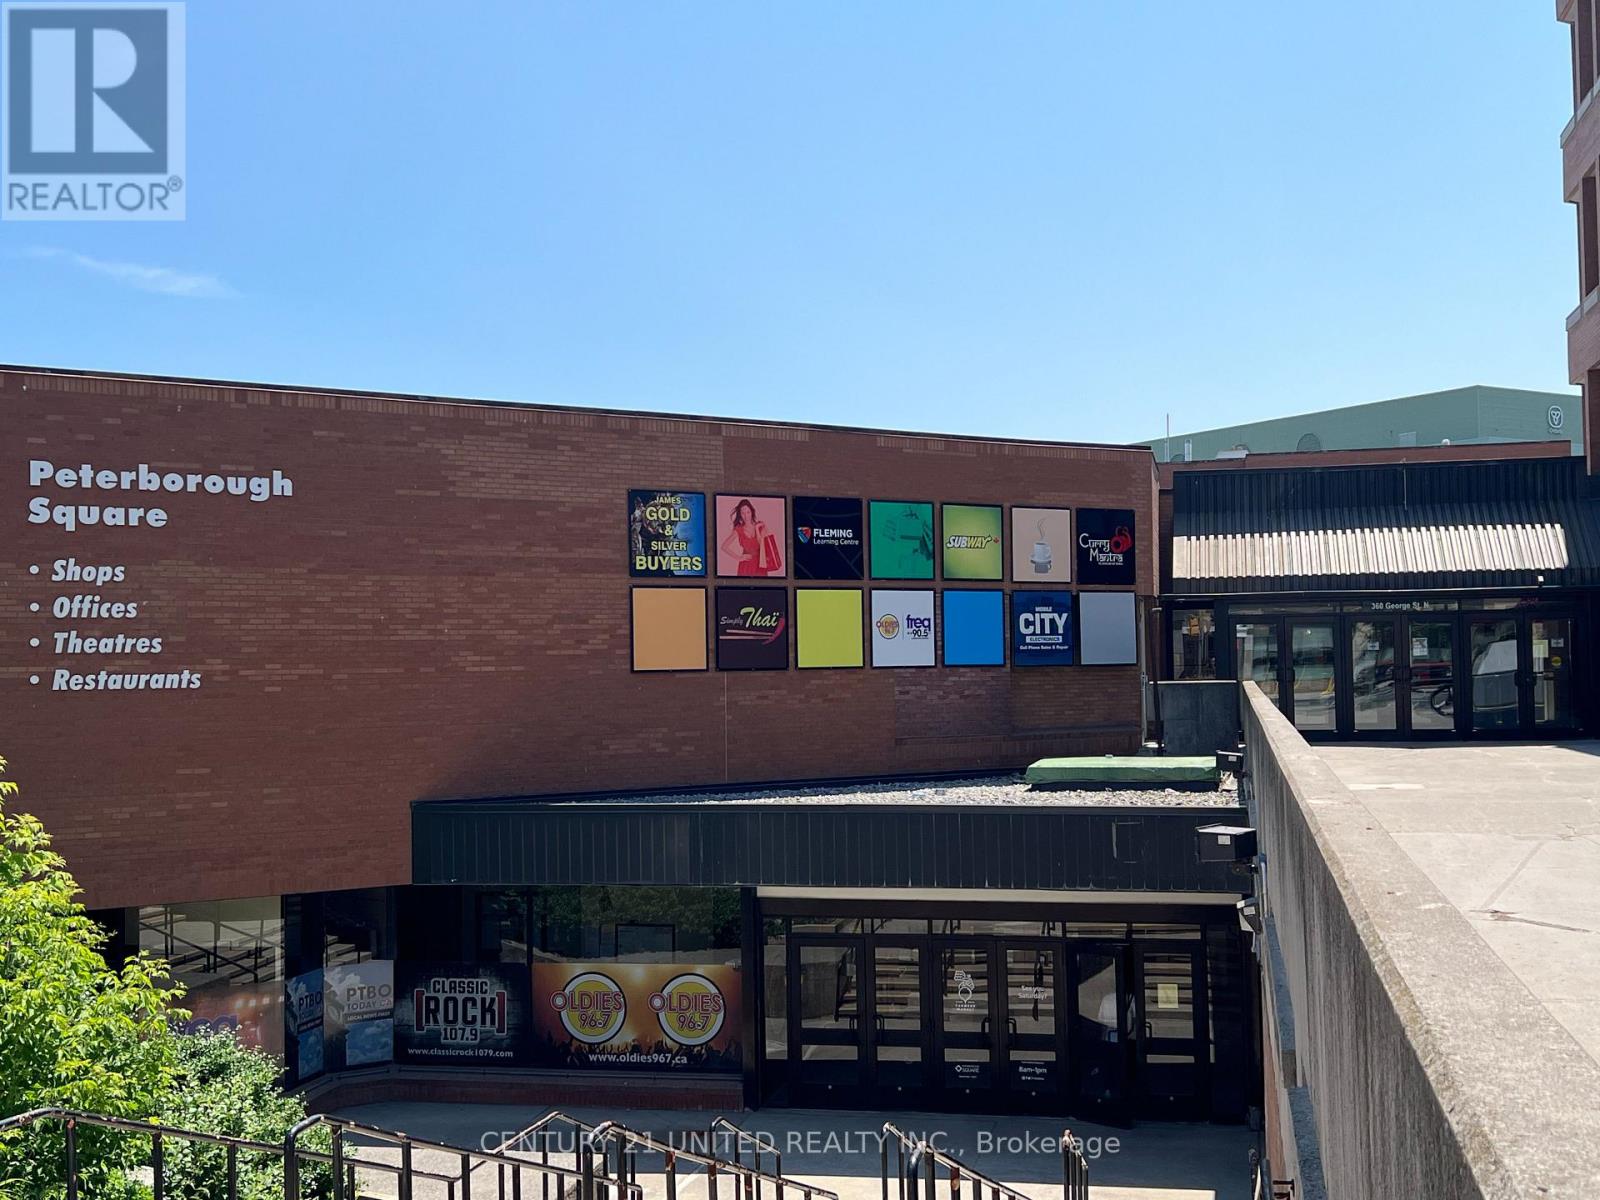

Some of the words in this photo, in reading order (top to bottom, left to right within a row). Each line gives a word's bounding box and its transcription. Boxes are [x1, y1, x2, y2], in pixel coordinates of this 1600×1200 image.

[29, 460, 293, 501] Peterborough
[655, 496, 682, 504] JAMES
[27, 496, 168, 531] Square
[645, 507, 690, 521] GOLD
[664, 524, 673, 536] &
[813, 528, 853, 538] FLEMING
[651, 541, 687, 551] SILVER
[813, 538, 839, 546] Learning
[947, 533, 992, 549] SUBWAY
[1079, 532, 1110, 552] Curry
[635, 556, 702, 571] BUYERS
[1089, 548, 1123, 562] Mantra
[51, 558, 125, 585] Shops
[52, 595, 138, 618] Offices
[1371, 602, 1384, 610] 360
[1385, 602, 1411, 611] George
[906, 614, 931, 631] freq
[1019, 612, 1068, 634] CITY
[912, 629, 929, 637] 90.5
[53, 631, 162, 654] Theatres
[52, 669, 201, 690] Restaurants
[347, 984, 392, 1002] PTBO
[432, 979, 489, 995] CLASSIC
[298, 991, 323, 1010] PTBO
[550, 990, 624, 1012] OLDIES
[648, 992, 722, 1014] OLDIES
[424, 995, 497, 1026] ROCK
[579, 1012, 612, 1029] 96.7
[677, 1013, 710, 1031] 96.7
[442, 1027, 478, 1042] 107.9
[408, 1047, 514, 1058] www.classicrock1079.com
[588, 1053, 688, 1065] www.oldies967.ca
